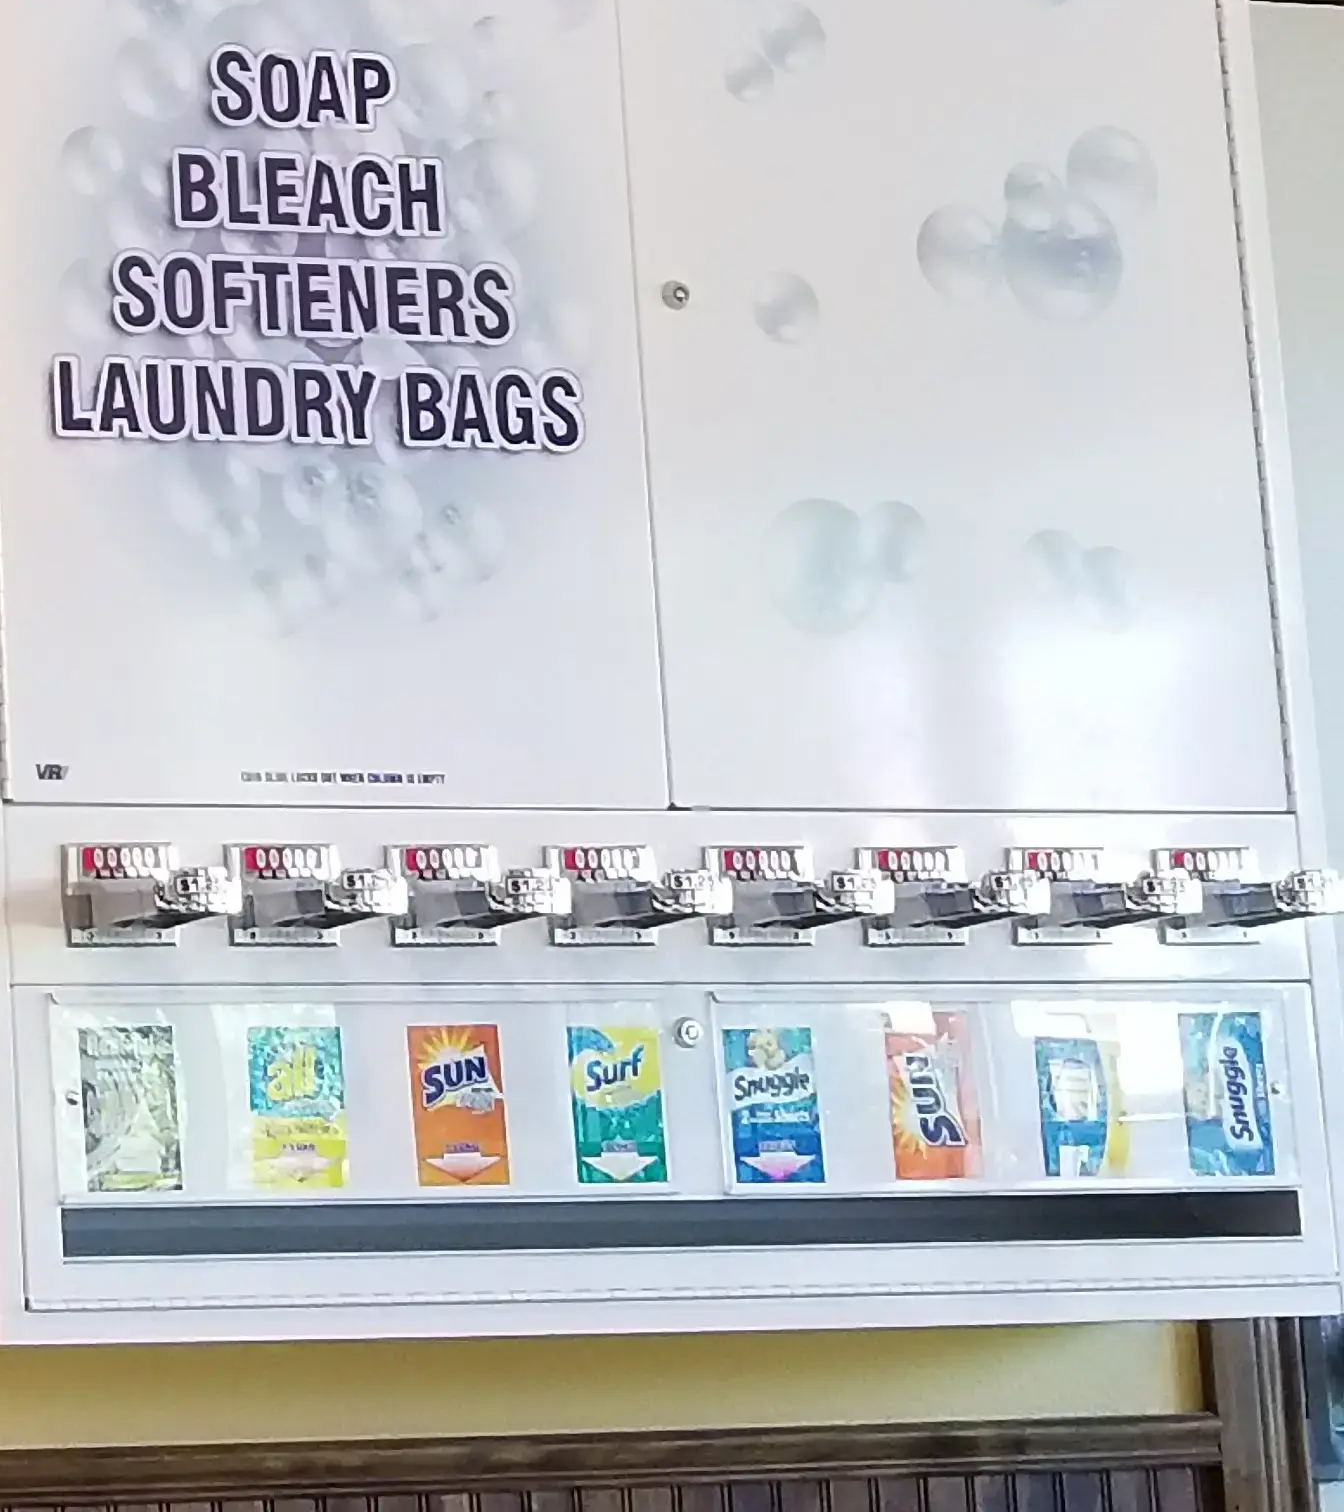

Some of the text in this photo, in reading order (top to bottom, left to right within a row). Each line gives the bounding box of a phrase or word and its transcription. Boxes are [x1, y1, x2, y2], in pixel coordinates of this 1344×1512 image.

[214, 49, 394, 126] SOAP
[176, 152, 442, 233] BLEACH
[115, 254, 513, 340] SOFTENERS
[56, 359, 581, 448] LAUNDRY BAGS
[266, 1045, 317, 1102] all
[423, 1055, 487, 1105] SUN
[585, 1044, 645, 1092] Surf
[734, 1066, 810, 1102] Snuggle
[1219, 1046, 1255, 1142] Snuggle
